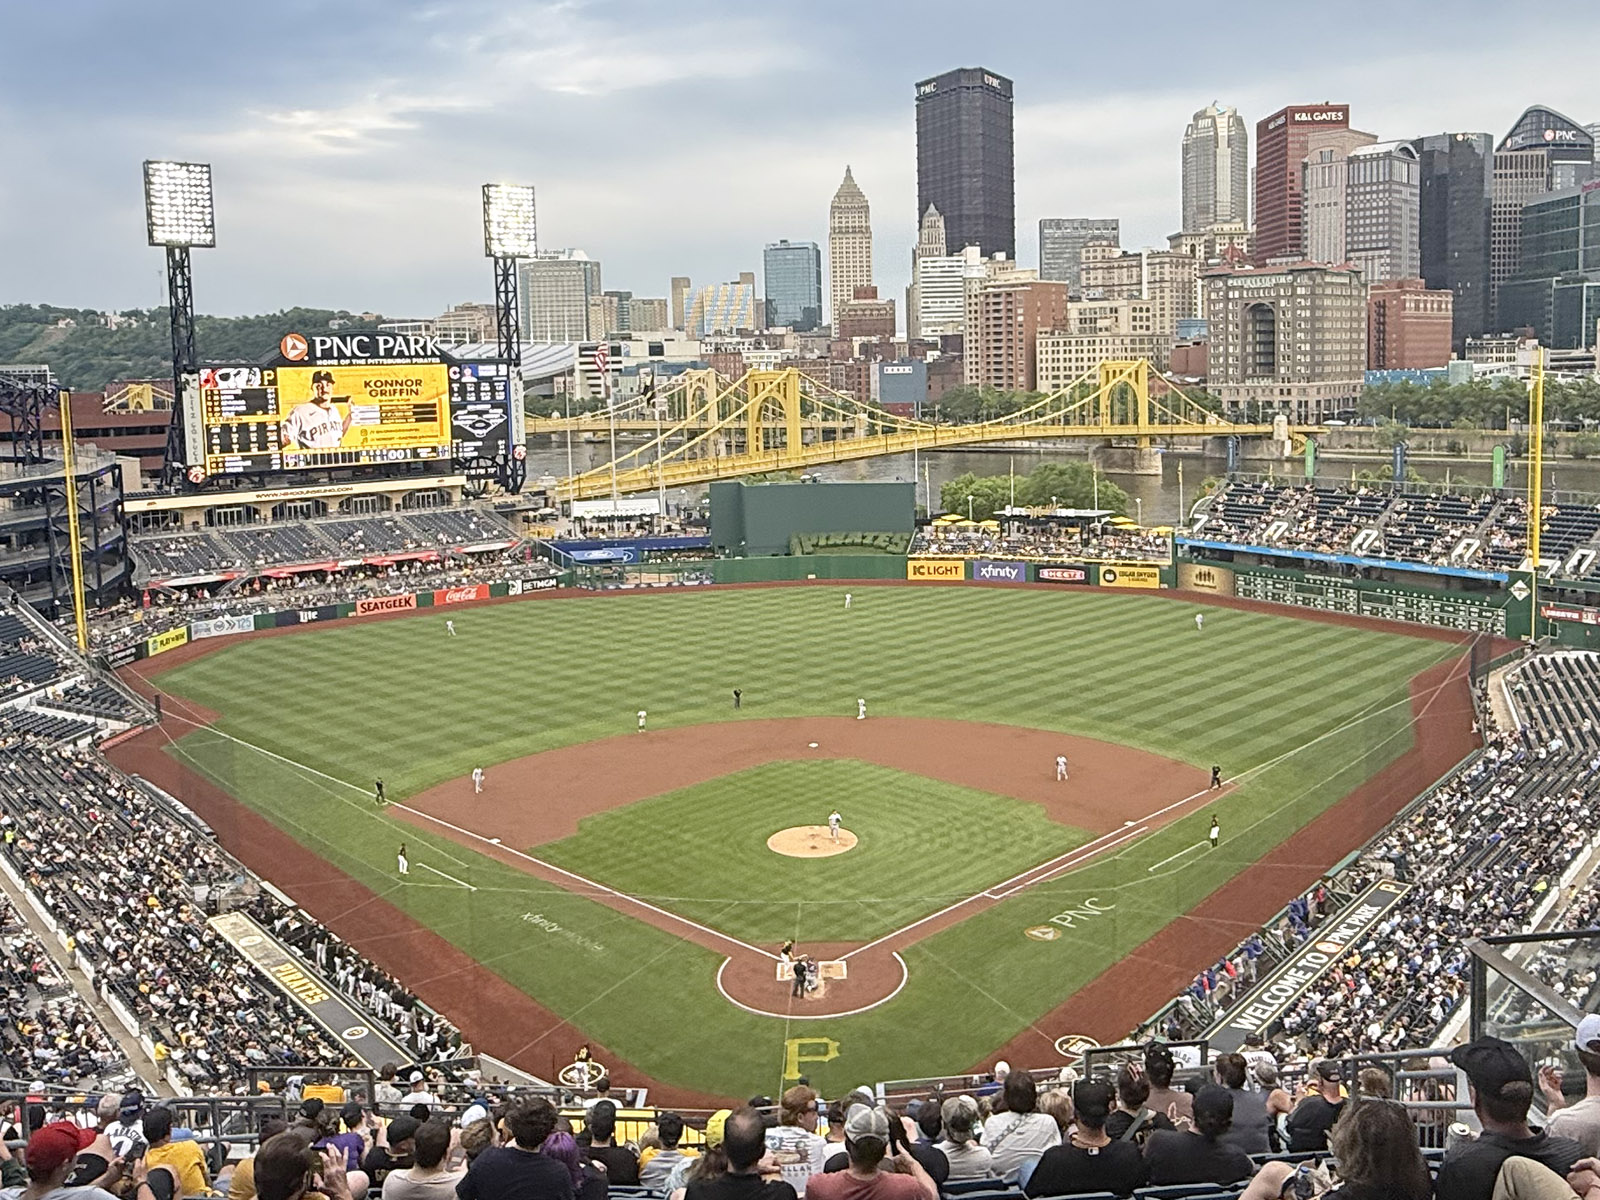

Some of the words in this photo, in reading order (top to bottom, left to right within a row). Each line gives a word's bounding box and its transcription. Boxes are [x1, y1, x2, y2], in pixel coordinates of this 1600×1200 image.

[984, 74, 1001, 89] UPMC
[1294, 112, 1312, 122] K&L
[1313, 111, 1343, 122] GATES
[1556, 130, 1577, 141] PNC
[312, 335, 371, 358] PNC
[375, 335, 441, 357] PARK
[263, 370, 275, 385] P
[364, 379, 423, 389] KONNOR
[369, 388, 419, 398] GRIFFIN
[912, 565, 926, 576] IC
[927, 565, 960, 576] LIGHT
[980, 564, 1018, 579] xfinity
[523, 578, 557, 590] BETMGM
[361, 596, 412, 613] SEATGEEK
[1049, 897, 1116, 928] PNC
[1230, 968, 1313, 1031] WELCOME
[1301, 952, 1330, 970] TO
[1326, 925, 1355, 945] PNC
[1349, 903, 1382, 927] PARK
[270, 962, 330, 1005] PIRATES
[783, 1037, 840, 1080] P
